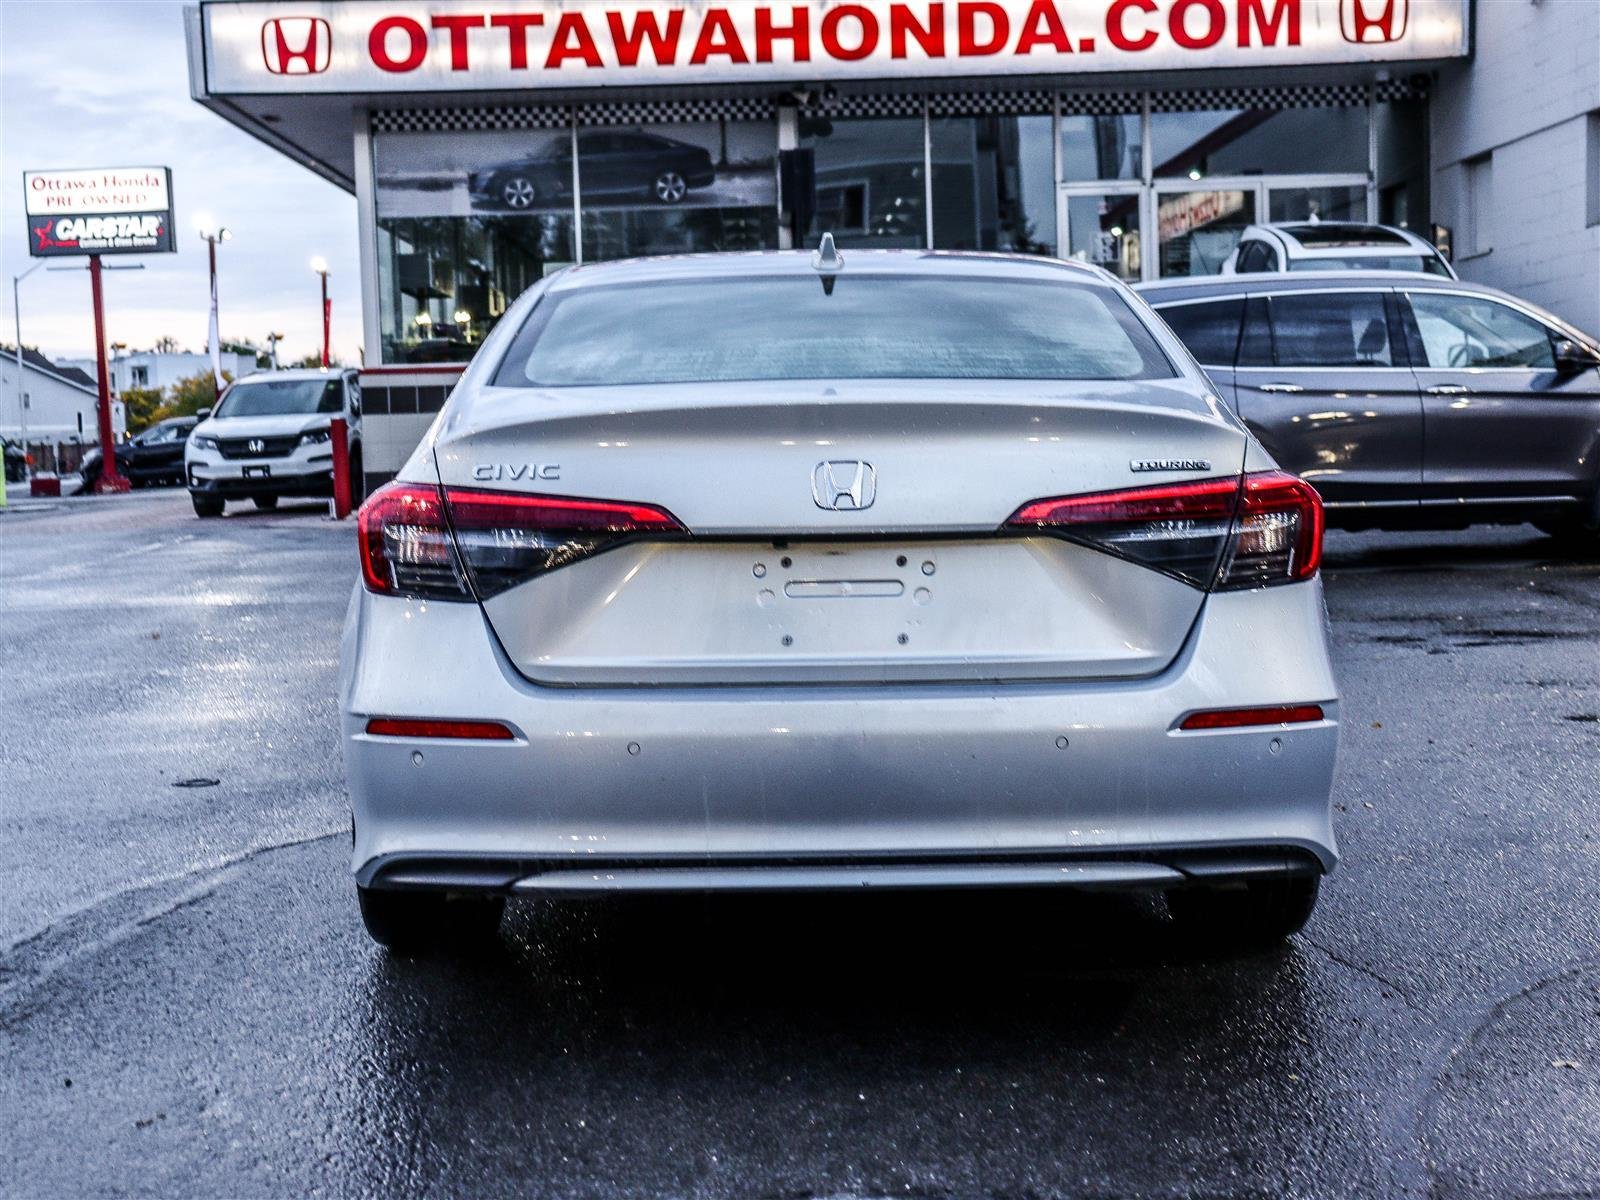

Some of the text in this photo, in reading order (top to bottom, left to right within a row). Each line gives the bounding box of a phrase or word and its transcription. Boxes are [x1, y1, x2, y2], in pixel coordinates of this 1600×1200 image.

[367, 0, 1301, 73] OTTAWAHONDA.COM
[31, 174, 160, 192] Ottawa Honda
[55, 215, 160, 241] CARSTAR
[472, 463, 561, 481] CIVIC
[1134, 459, 1208, 472] TOURING
